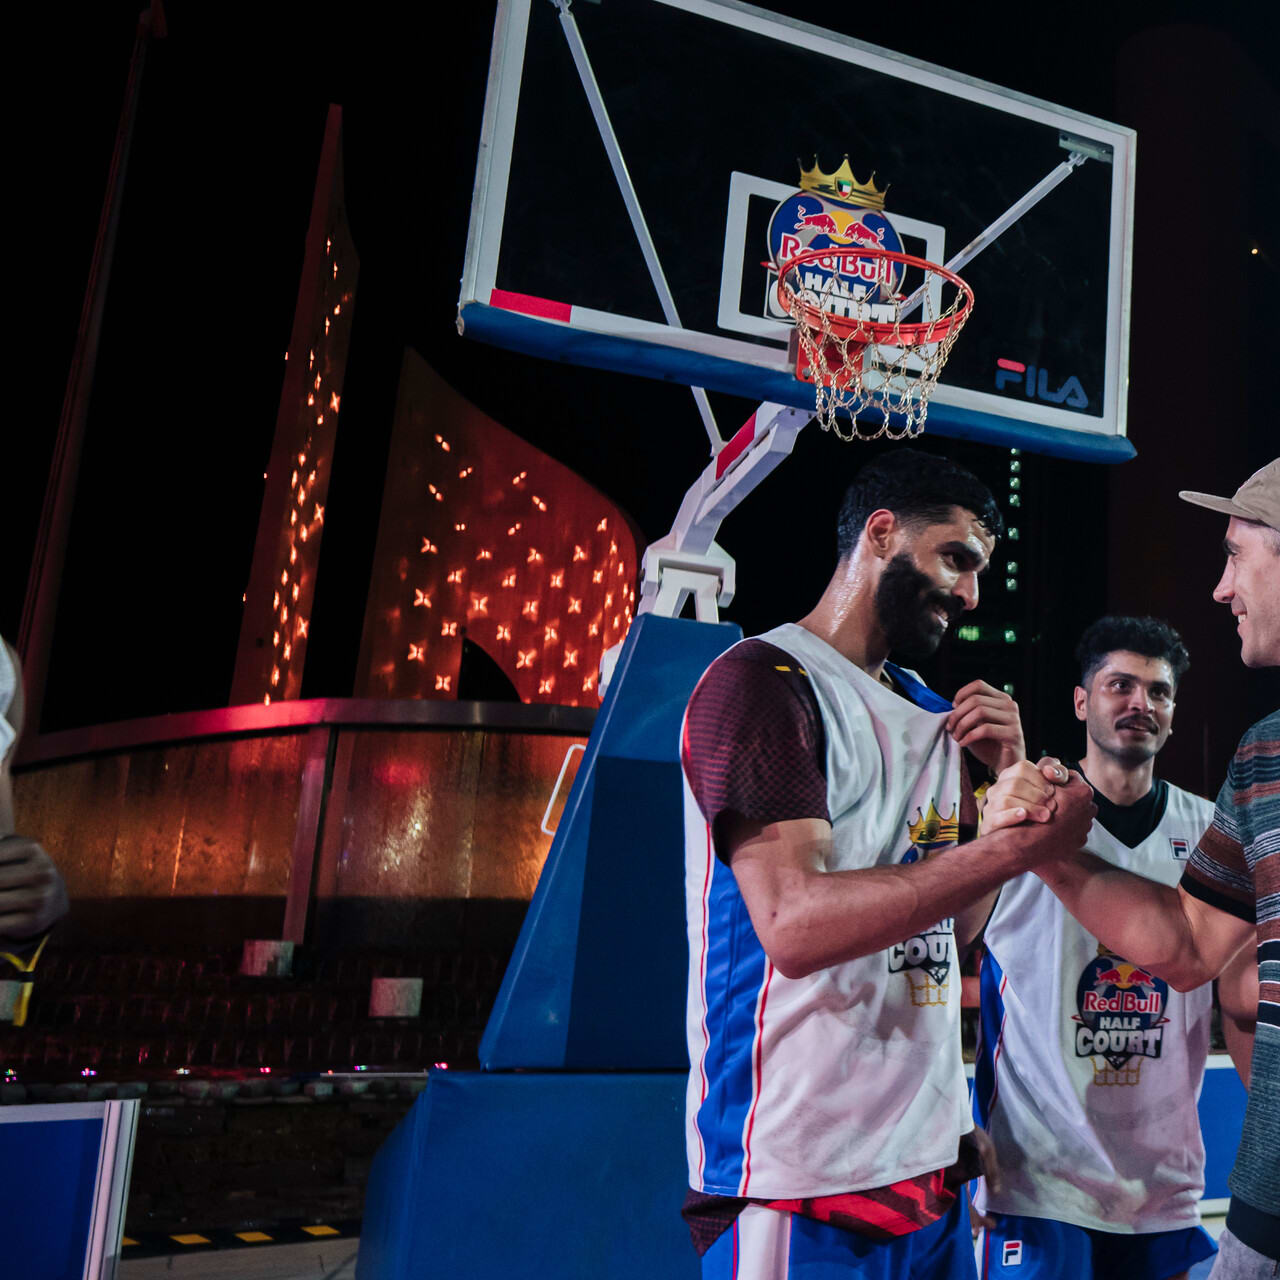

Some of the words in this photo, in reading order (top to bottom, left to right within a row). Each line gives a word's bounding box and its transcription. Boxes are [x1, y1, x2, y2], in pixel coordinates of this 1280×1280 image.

[995, 358, 1088, 409] FILA
[1083, 990, 1121, 1013] Red
[1121, 991, 1161, 1014] Bull
[1099, 1016, 1141, 1030] HALF
[1076, 1026, 1162, 1057] COURT
